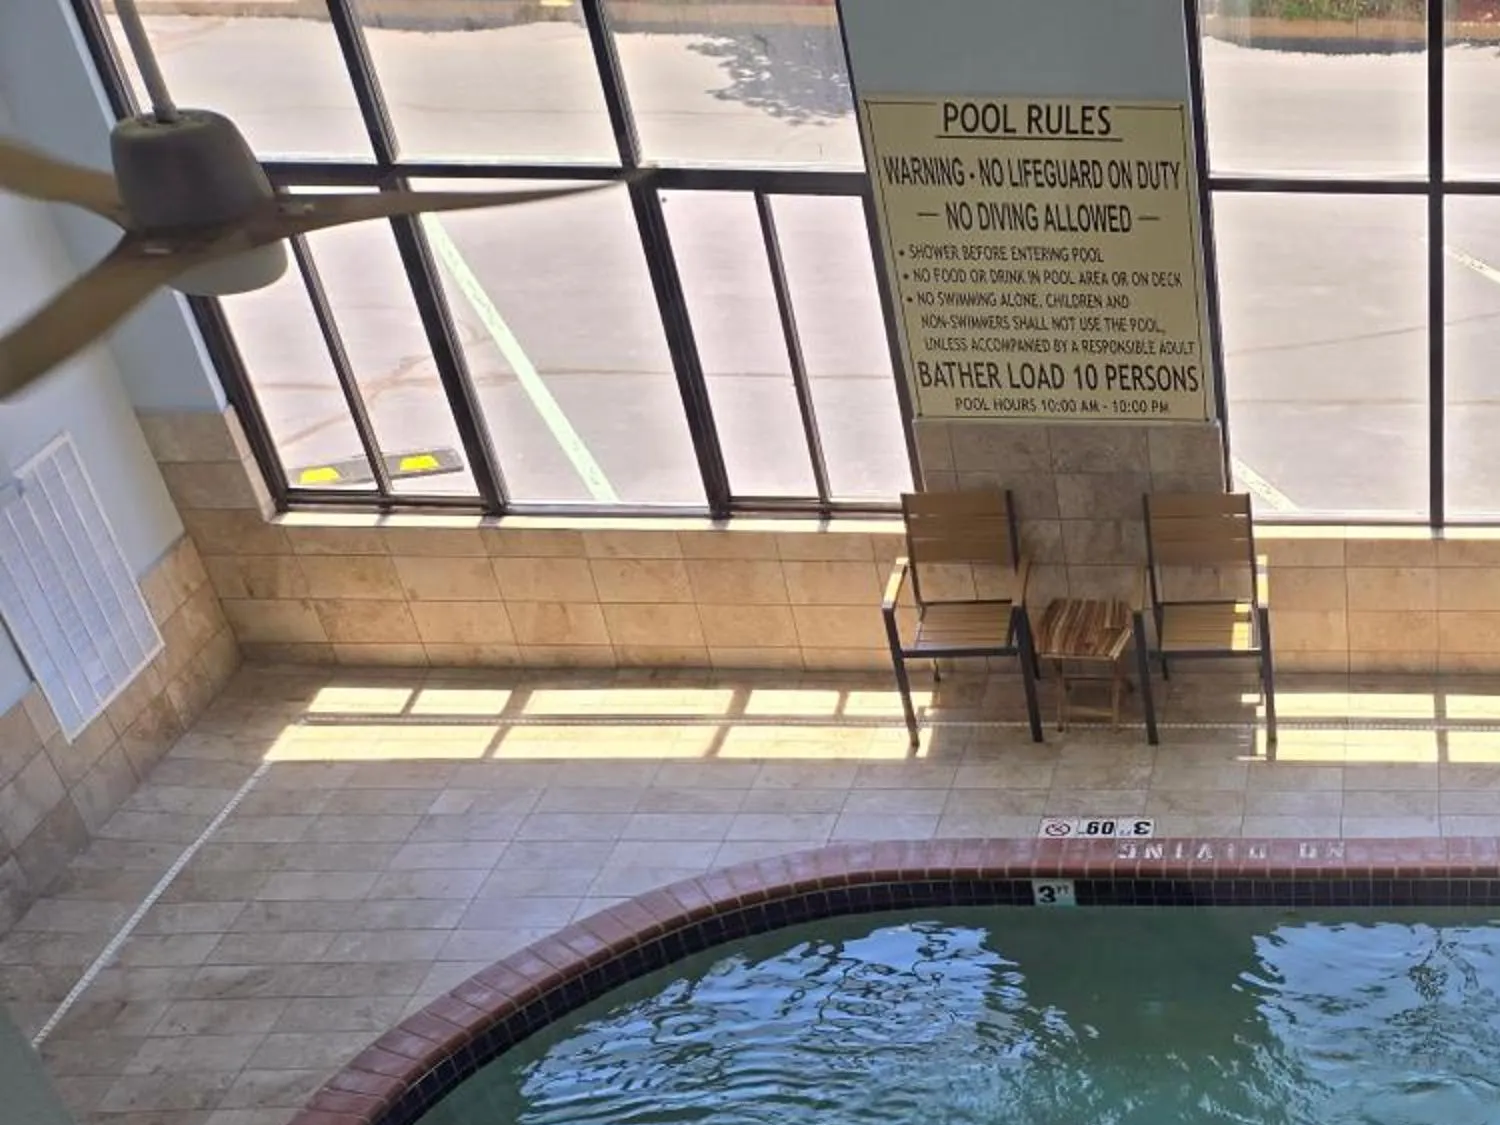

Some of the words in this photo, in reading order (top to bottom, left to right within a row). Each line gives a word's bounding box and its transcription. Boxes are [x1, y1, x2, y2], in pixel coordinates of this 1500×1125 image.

[943, 103, 1016, 133] POOL
[1027, 105, 1112, 135] RULES
[884, 157, 965, 187] WARNING
[978, 158, 1004, 188] NO
[1008, 159, 1103, 189] LIFEGUARD
[1107, 161, 1133, 190] ON
[1137, 161, 1181, 191] DUTY
[946, 202, 973, 231] NO
[978, 203, 1038, 232] DIVING
[1044, 204, 1131, 233] ALLOWED
[908, 244, 959, 260] SHOWER
[961, 245, 1009, 261] BEFORE
[1010, 246, 1069, 262] ENTERING
[1071, 247, 1104, 263] POOL
[913, 267, 931, 283] NO
[934, 268, 967, 283] FOOD
[970, 269, 988, 283] OR
[990, 269, 1025, 284] DRINK
[1028, 269, 1041, 284] IN
[1043, 269, 1076, 285] POOL
[1080, 270, 1109, 286] AREA
[1112, 271, 1129, 287] OR
[1132, 271, 1149, 287] ON
[1152, 271, 1183, 288] DECK
[917, 291, 935, 306] NO
[937, 291, 997, 308] SWIMMING
[1045, 293, 1102, 309] CHILDREN
[1106, 294, 1129, 309] AND
[921, 313, 1009, 330] NON-SWIMMERS
[1012, 315, 1048, 331] SHALL
[1051, 316, 1076, 331] NOT
[1079, 317, 1101, 332] USE
[1104, 317, 1128, 332] THE
[925, 336, 968, 351] UNLESS
[971, 337, 1051, 353] ACCOMPANIED
[1053, 338, 1068, 353] BY
[1070, 339, 1079, 353] A
[1081, 339, 1156, 355] RESPONSIBLE
[917, 361, 1002, 389] BATHER
[1006, 362, 1065, 390] LOAD
[1073, 363, 1099, 391] 10
[1105, 364, 1199, 392] PERSONS
[955, 397, 991, 411] POOL
[993, 398, 1037, 413] HOURS
[1040, 398, 1077, 413] 10:00
[1081, 399, 1100, 413] AM
[1112, 400, 1148, 414] 10:00
[1151, 400, 1170, 414] PM
